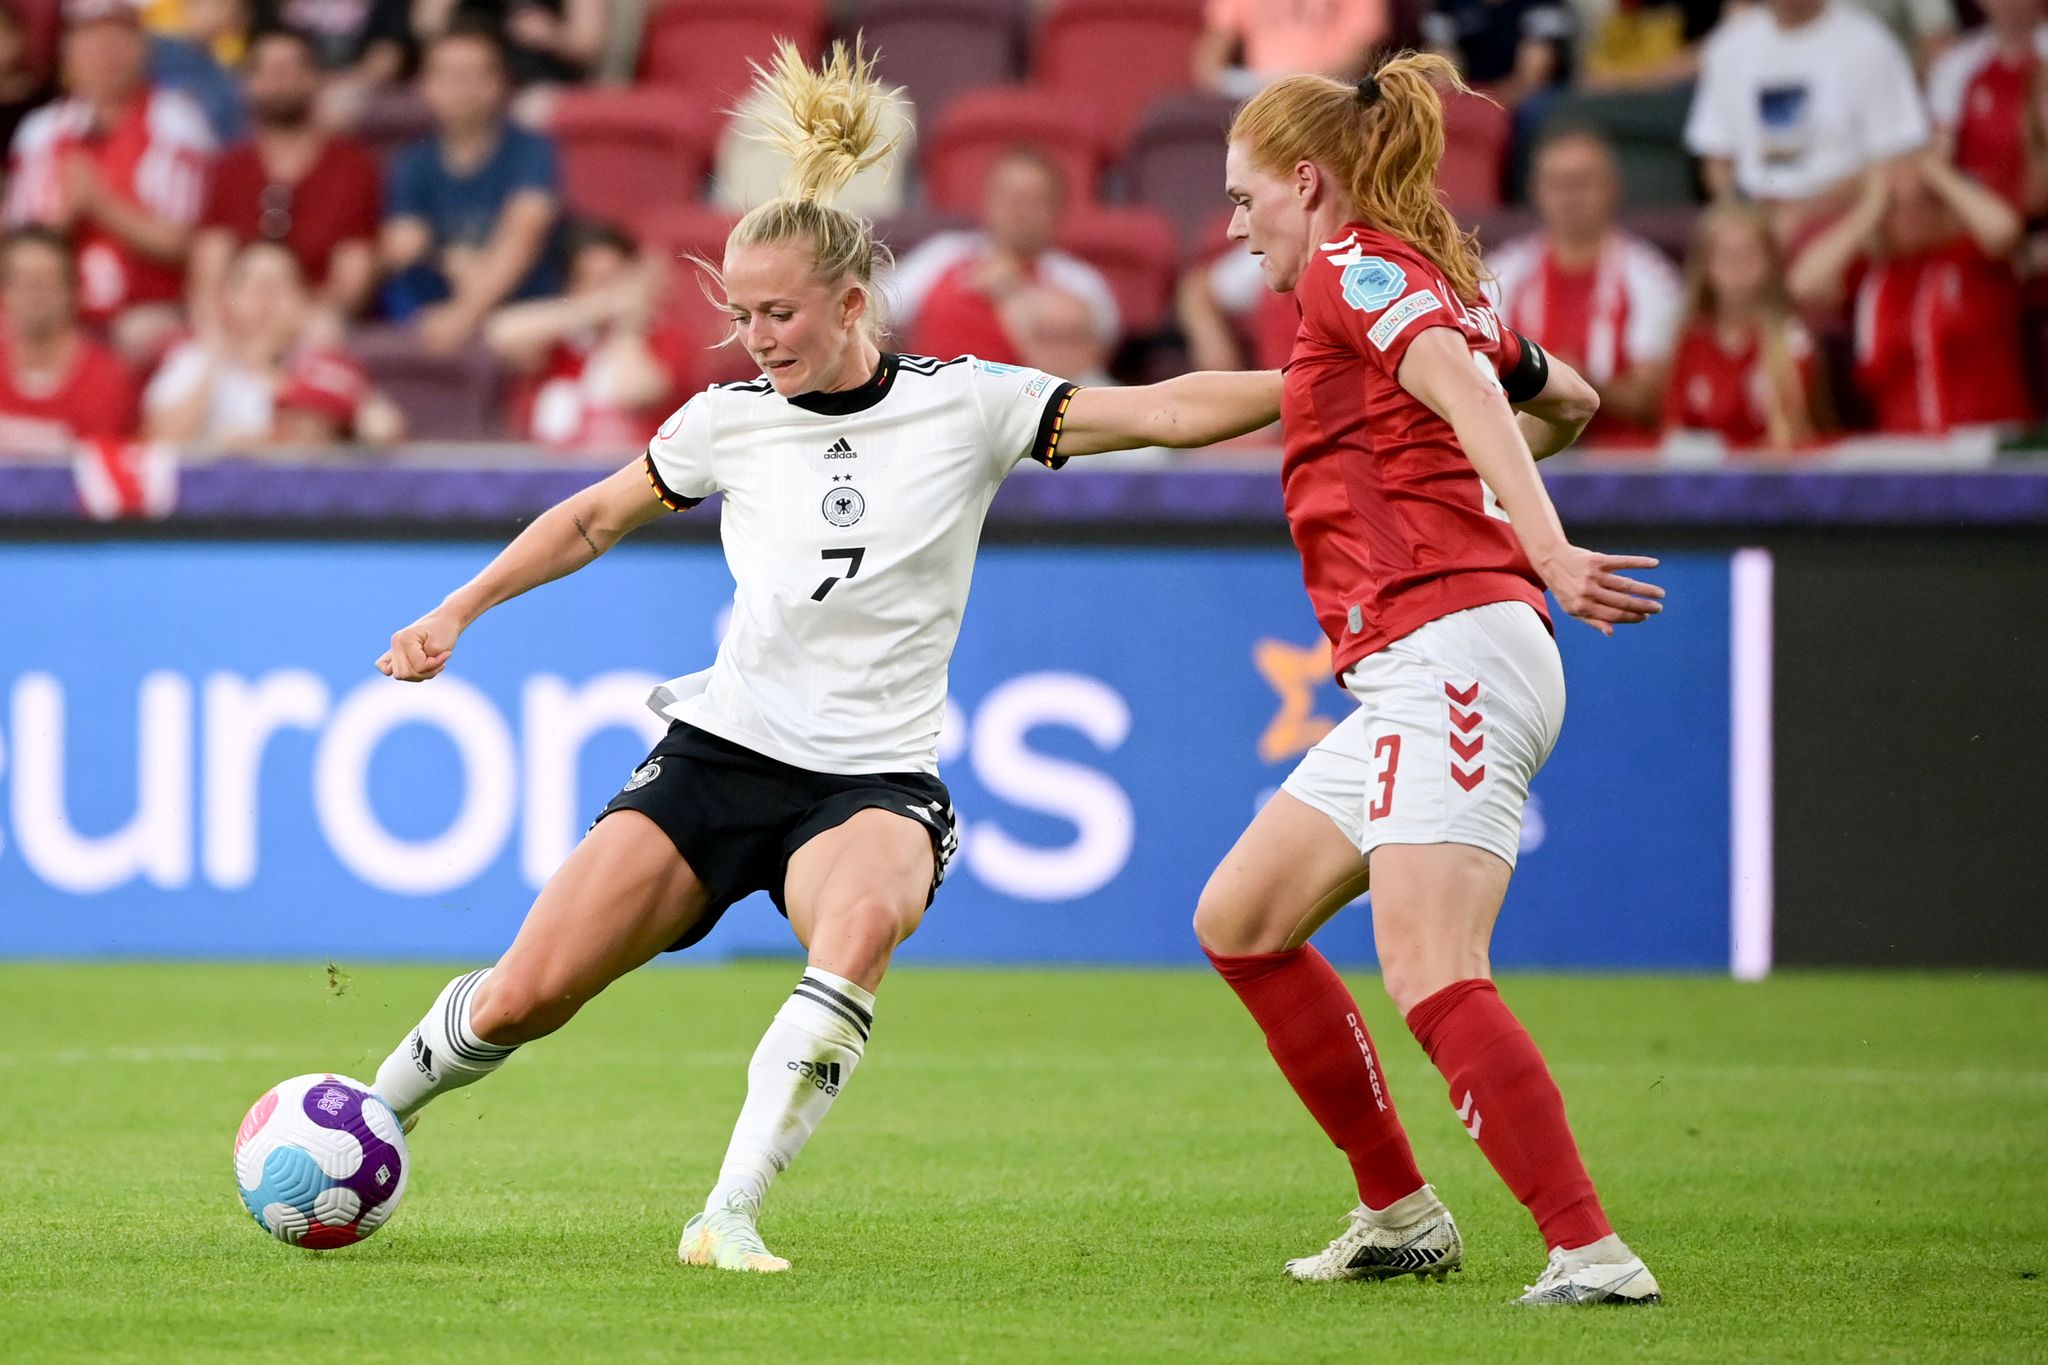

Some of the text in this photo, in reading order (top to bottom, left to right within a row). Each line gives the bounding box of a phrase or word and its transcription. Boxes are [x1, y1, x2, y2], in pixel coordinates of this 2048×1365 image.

[823, 451, 858, 460] adidas
[810, 547, 866, 602] 7
[1369, 734, 1402, 822] 3
[787, 1061, 839, 1097] adidas
[1346, 1012, 1388, 1113] DANMARK
